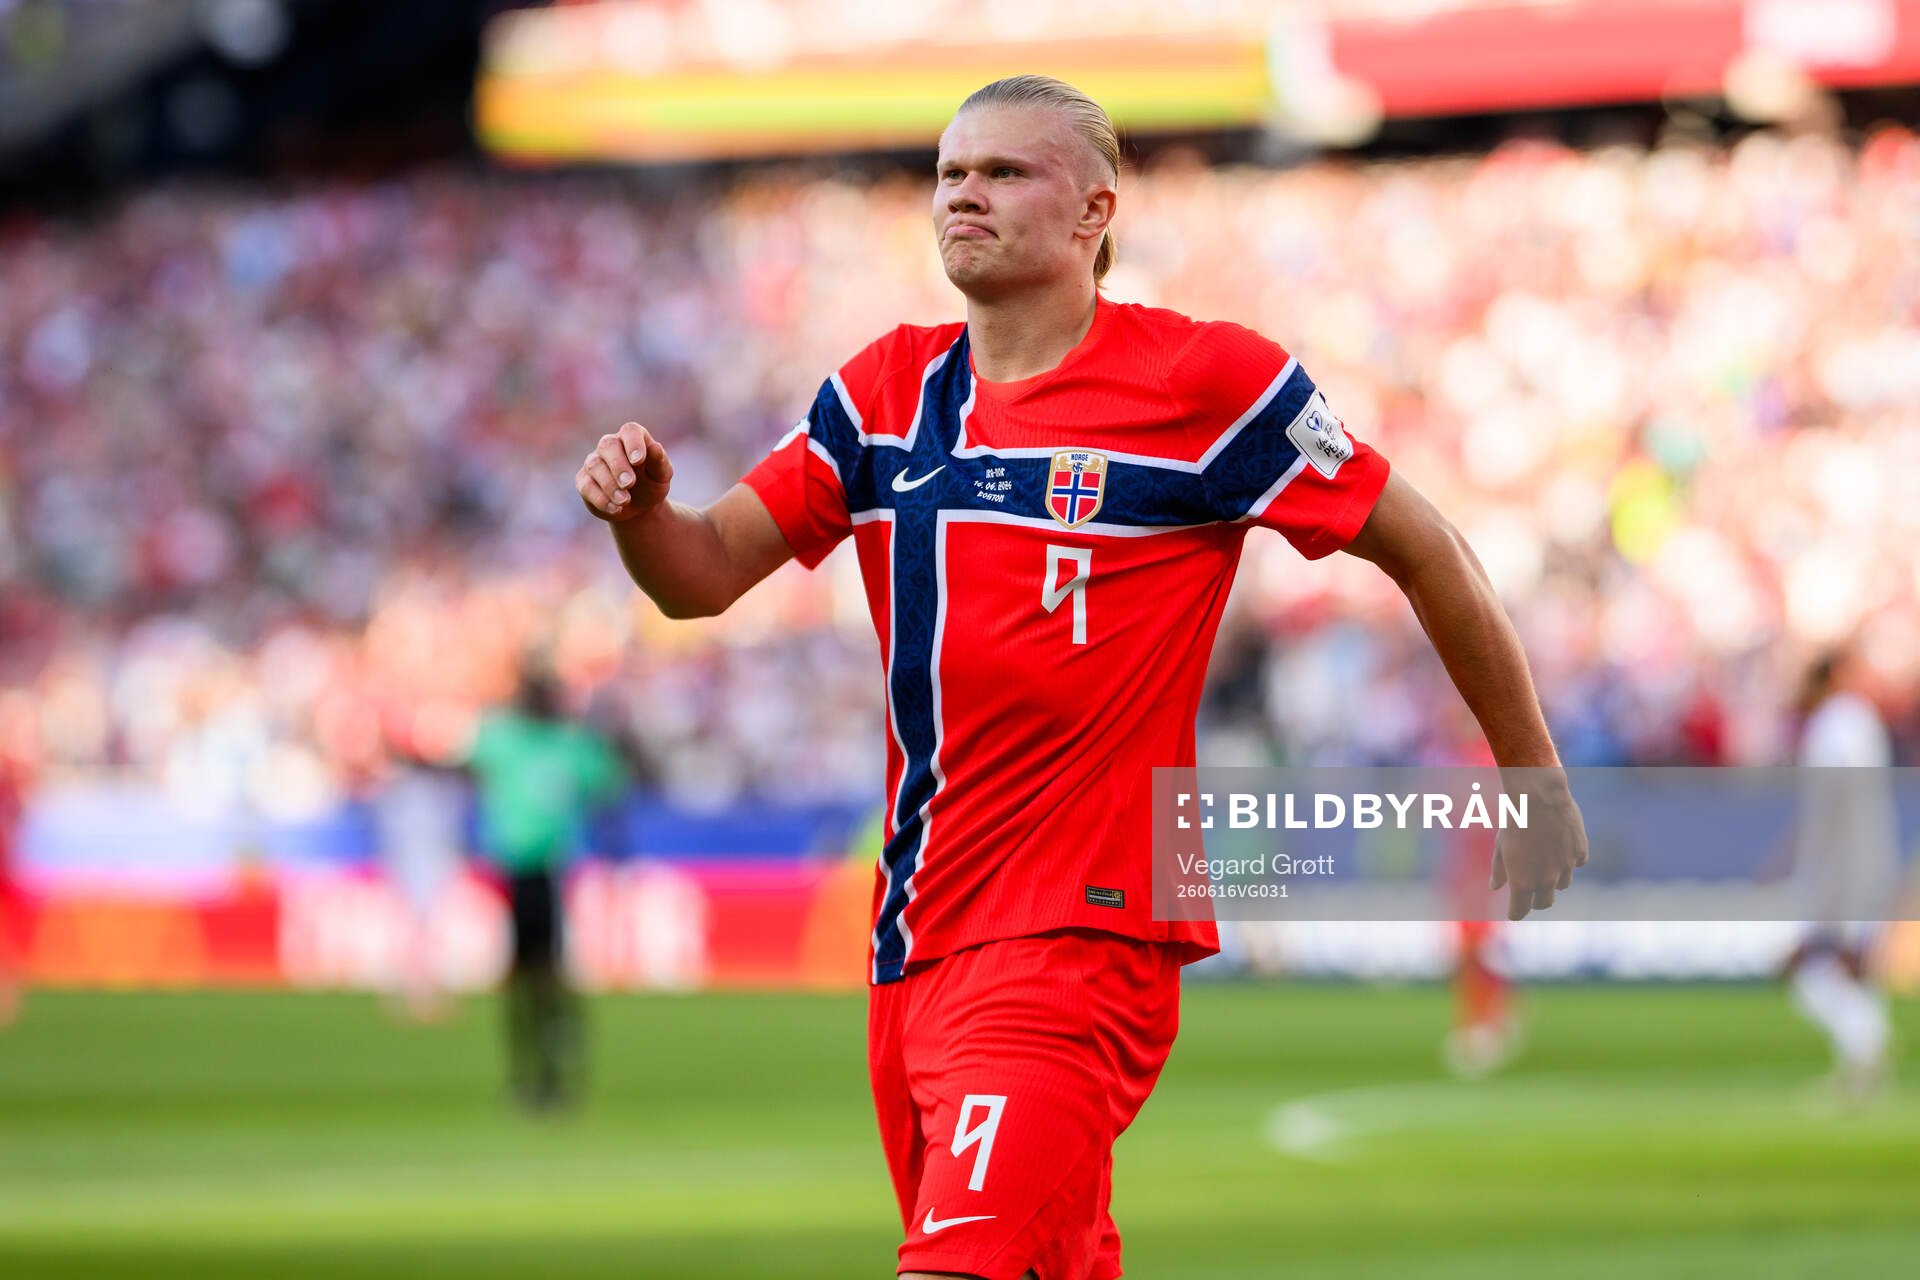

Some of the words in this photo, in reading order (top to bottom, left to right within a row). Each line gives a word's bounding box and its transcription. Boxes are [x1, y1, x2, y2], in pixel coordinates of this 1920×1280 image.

[1071, 453, 1089, 462] NORGE
[977, 491, 1004, 503] BOSTON
[1041, 543, 1093, 645] 9
[950, 1094, 1008, 1192] 9
